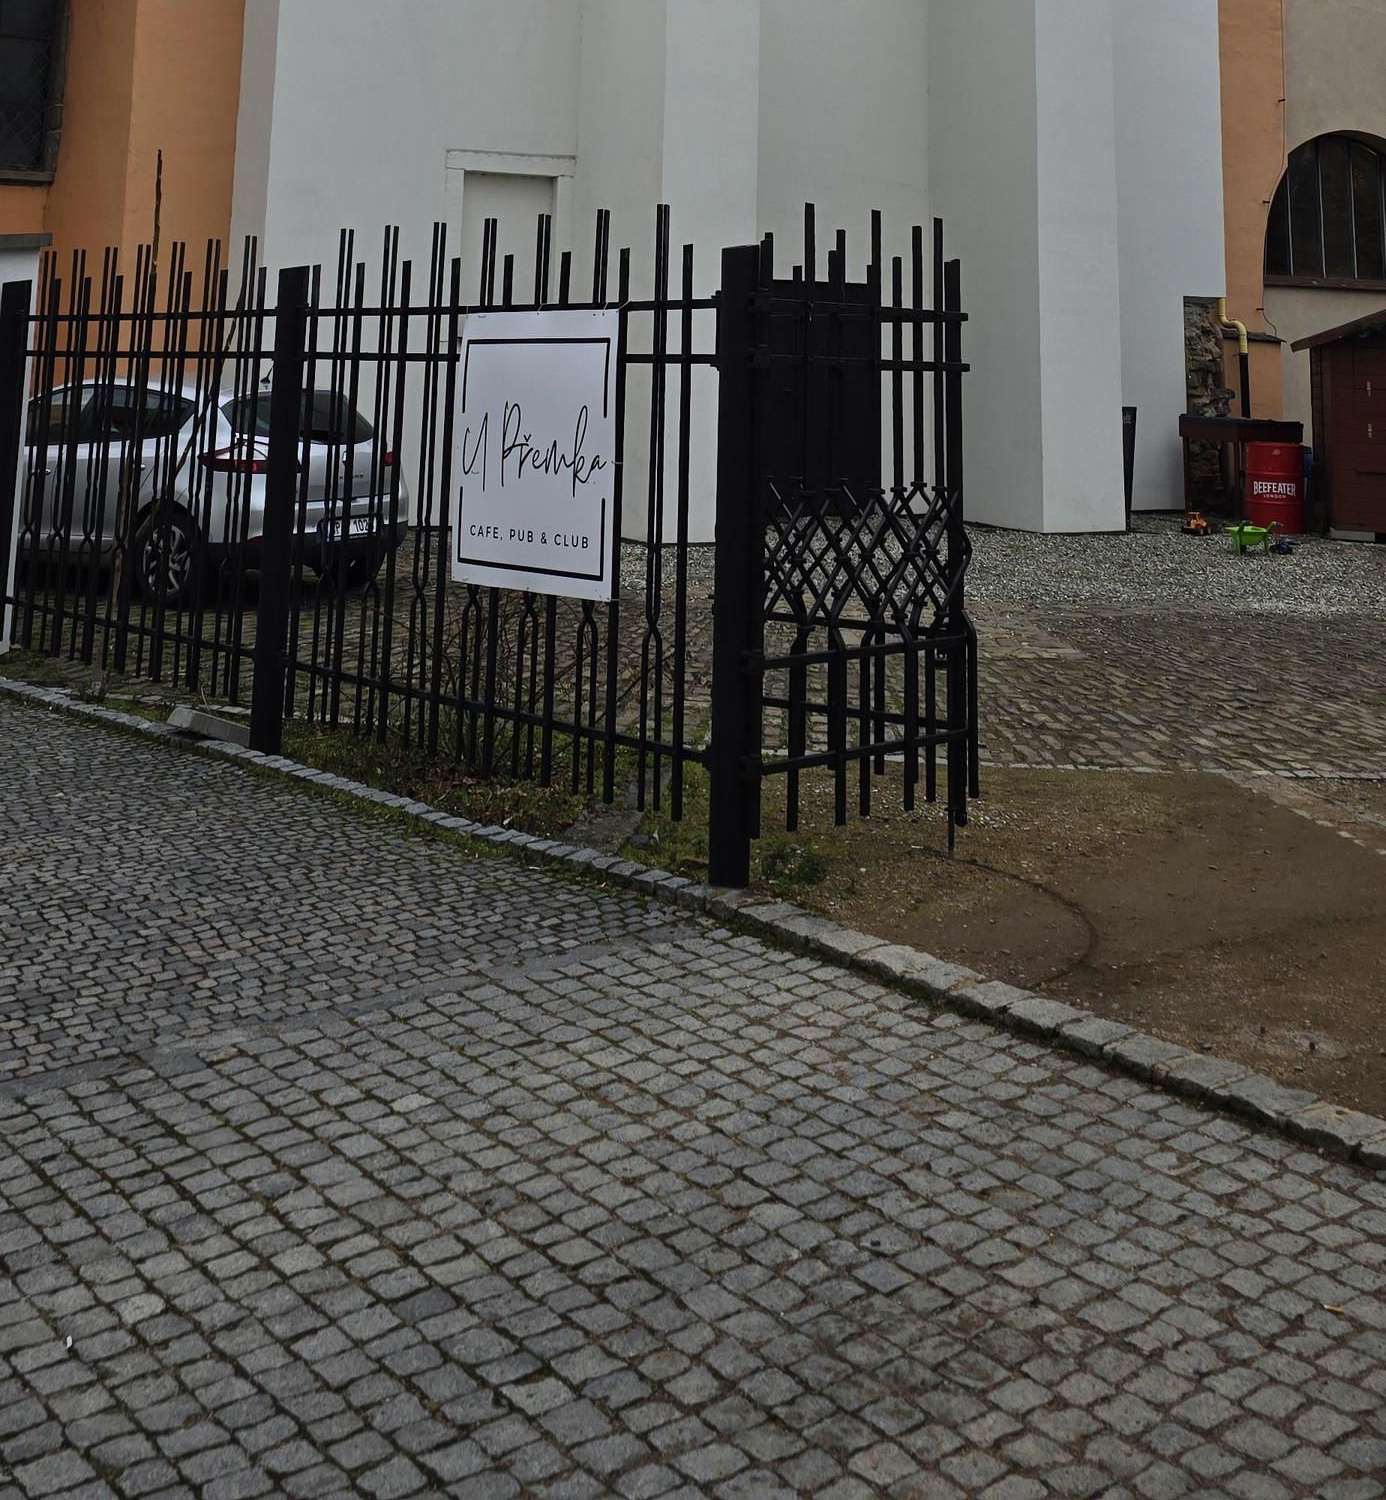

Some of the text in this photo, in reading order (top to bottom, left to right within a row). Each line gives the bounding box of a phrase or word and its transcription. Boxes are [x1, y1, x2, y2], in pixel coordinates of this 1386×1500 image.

[501, 401, 607, 498] Přemka
[1253, 481, 1296, 497] BEEFEATER
[470, 524, 589, 549] CAFE, PUB & CLUB
